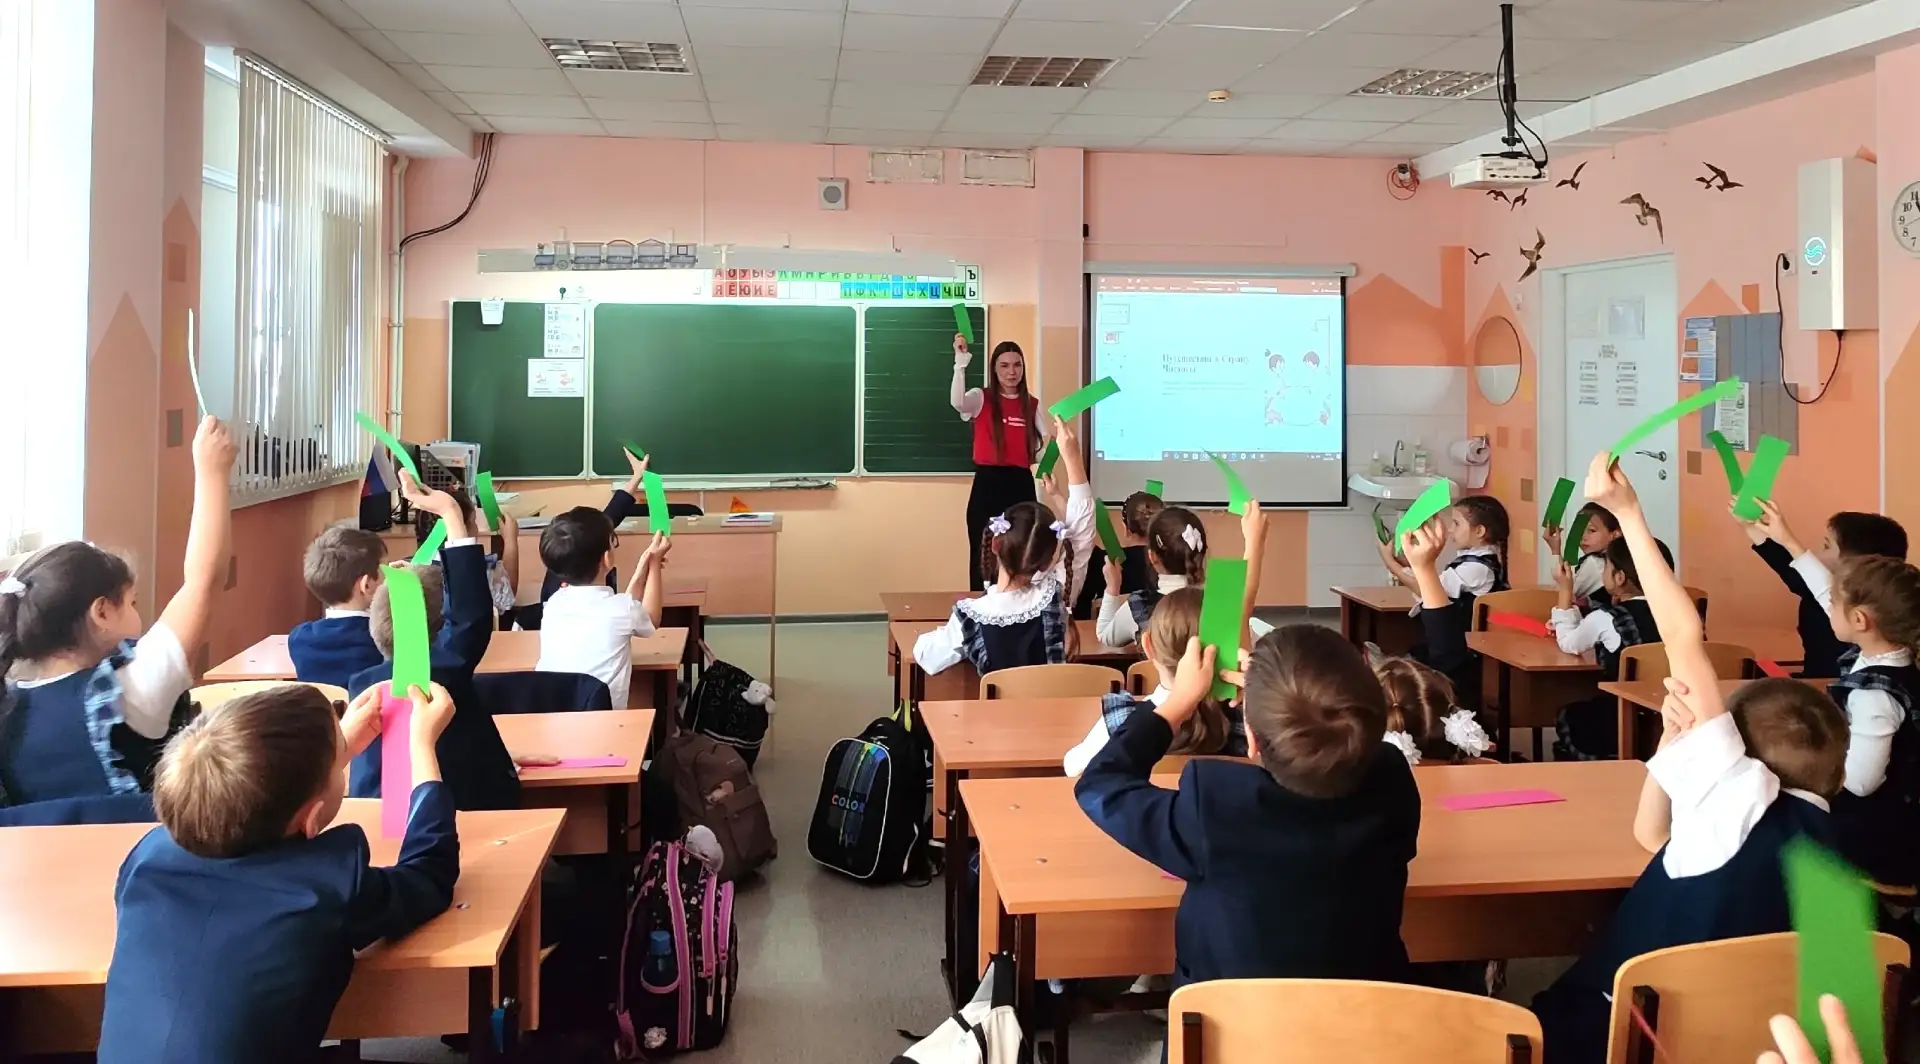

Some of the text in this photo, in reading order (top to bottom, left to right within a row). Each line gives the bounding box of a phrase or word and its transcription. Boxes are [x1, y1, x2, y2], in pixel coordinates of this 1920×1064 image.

[1903, 202, 1912, 212] 10
[1899, 215, 1905, 225] 9
[1902, 227, 1909, 238] 8
[1911, 236, 1917, 247] 7
